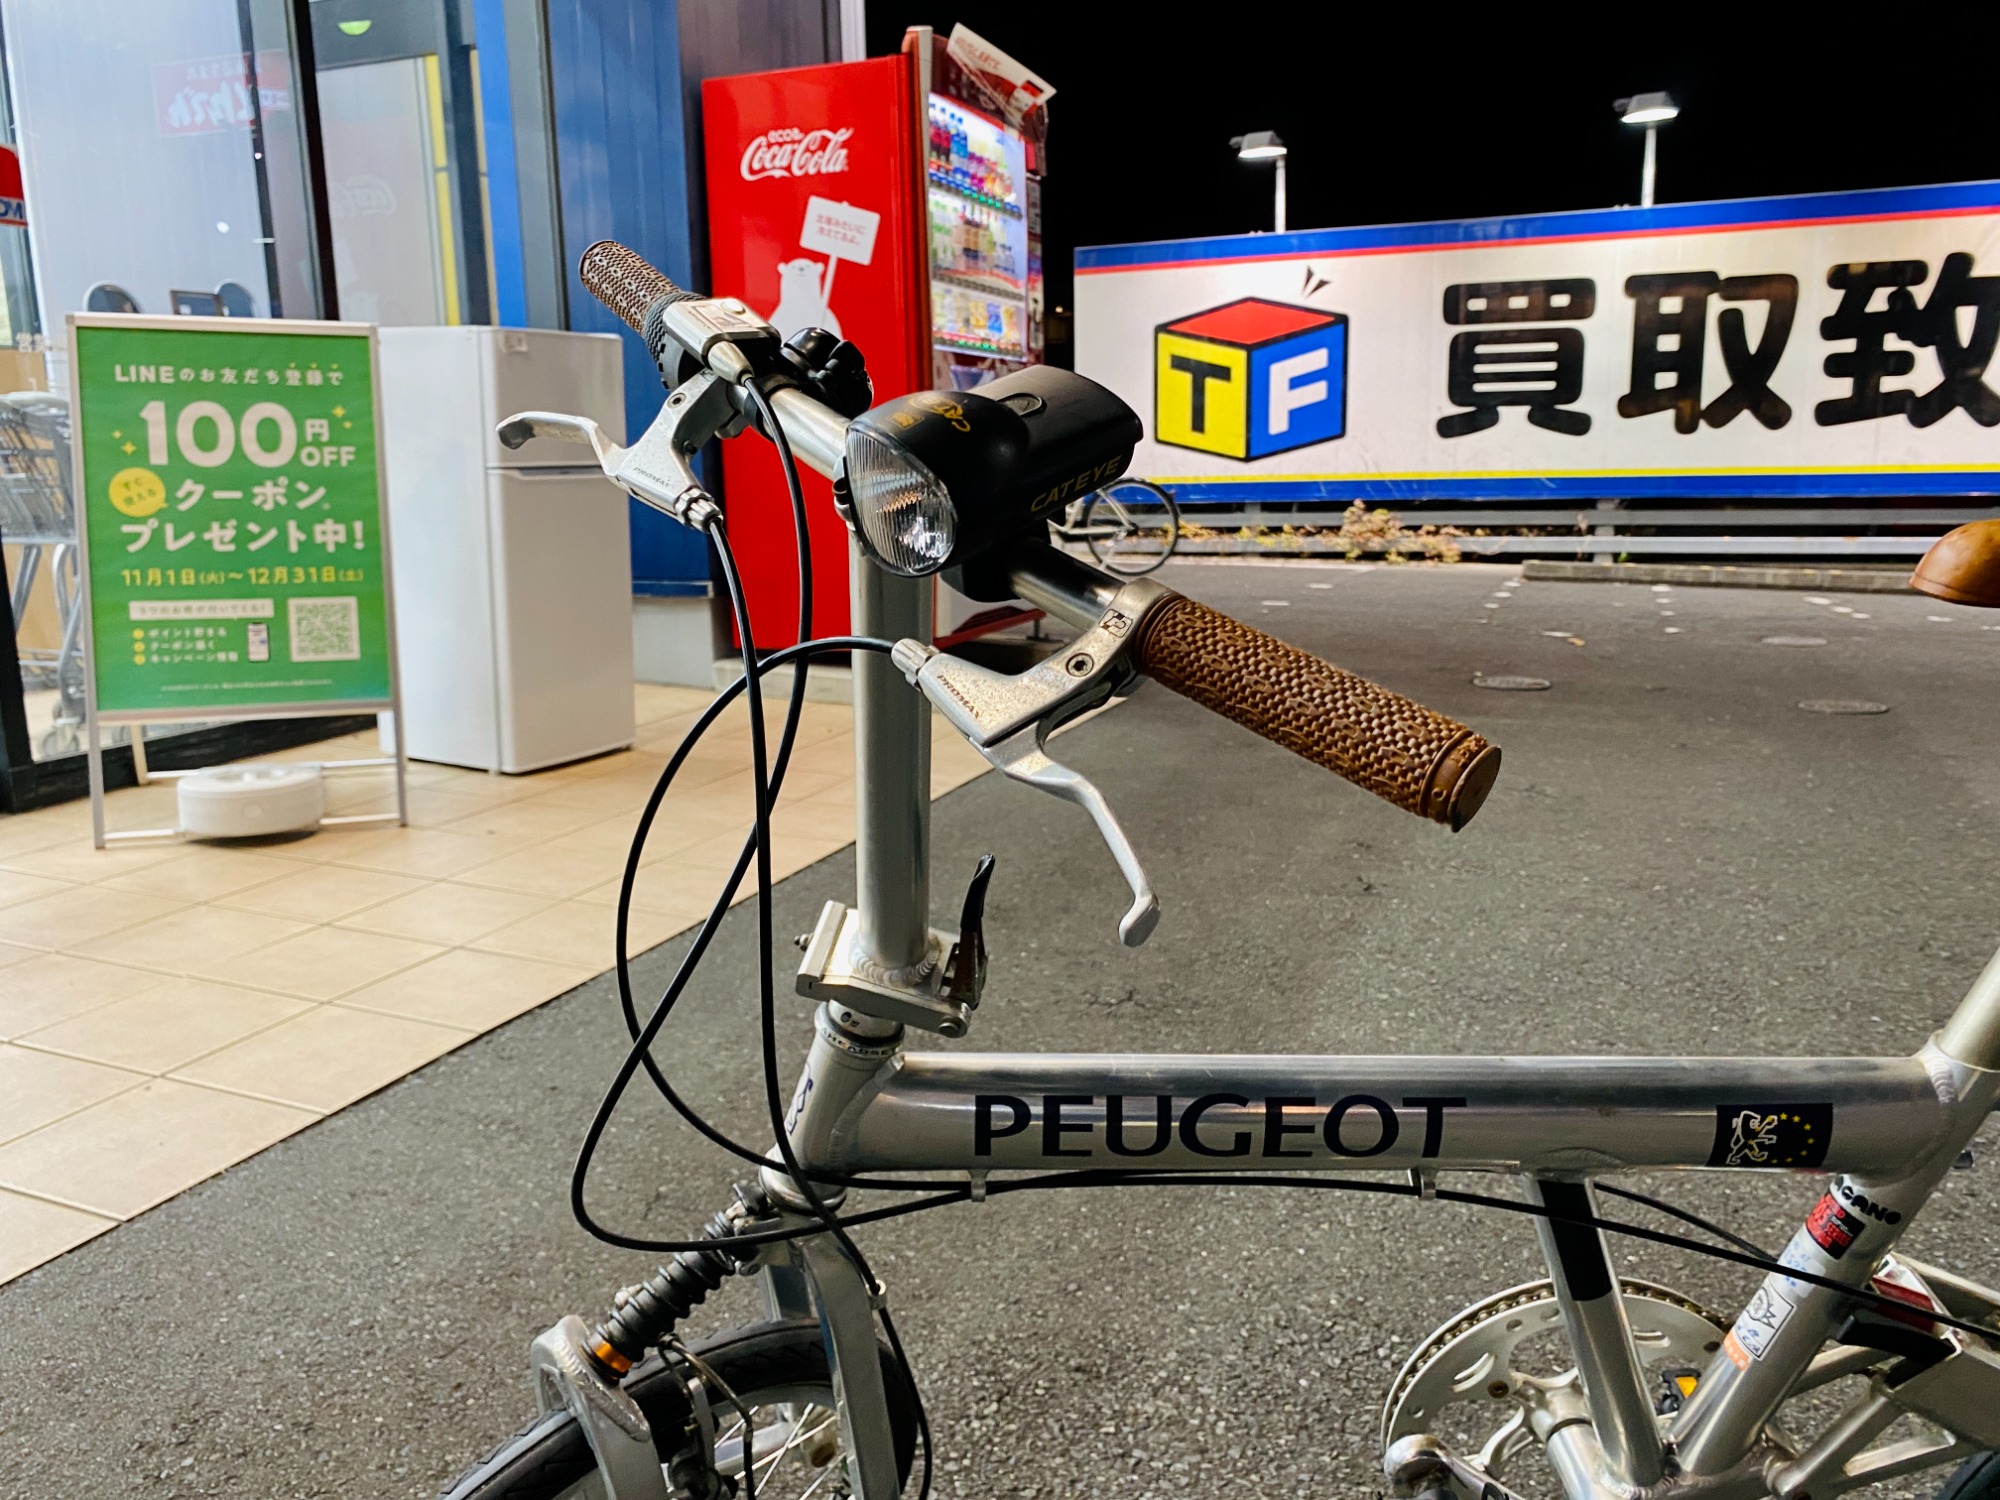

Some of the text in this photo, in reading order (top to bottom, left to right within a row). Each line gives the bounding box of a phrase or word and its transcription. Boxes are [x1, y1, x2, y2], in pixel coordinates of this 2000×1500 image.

[740, 128, 854, 181] Coca-Cola
[1437, 252, 2000, 437] 買取致
[115, 364, 344, 386] LINEのお友だち登録で
[139, 400, 356, 468] 100 円 OFF
[174, 477, 327, 511] クーポン
[1030, 455, 1122, 512] CATEYE
[120, 518, 365, 553] プレゼント中!
[974, 1093, 1467, 1158] PEUGEOT
